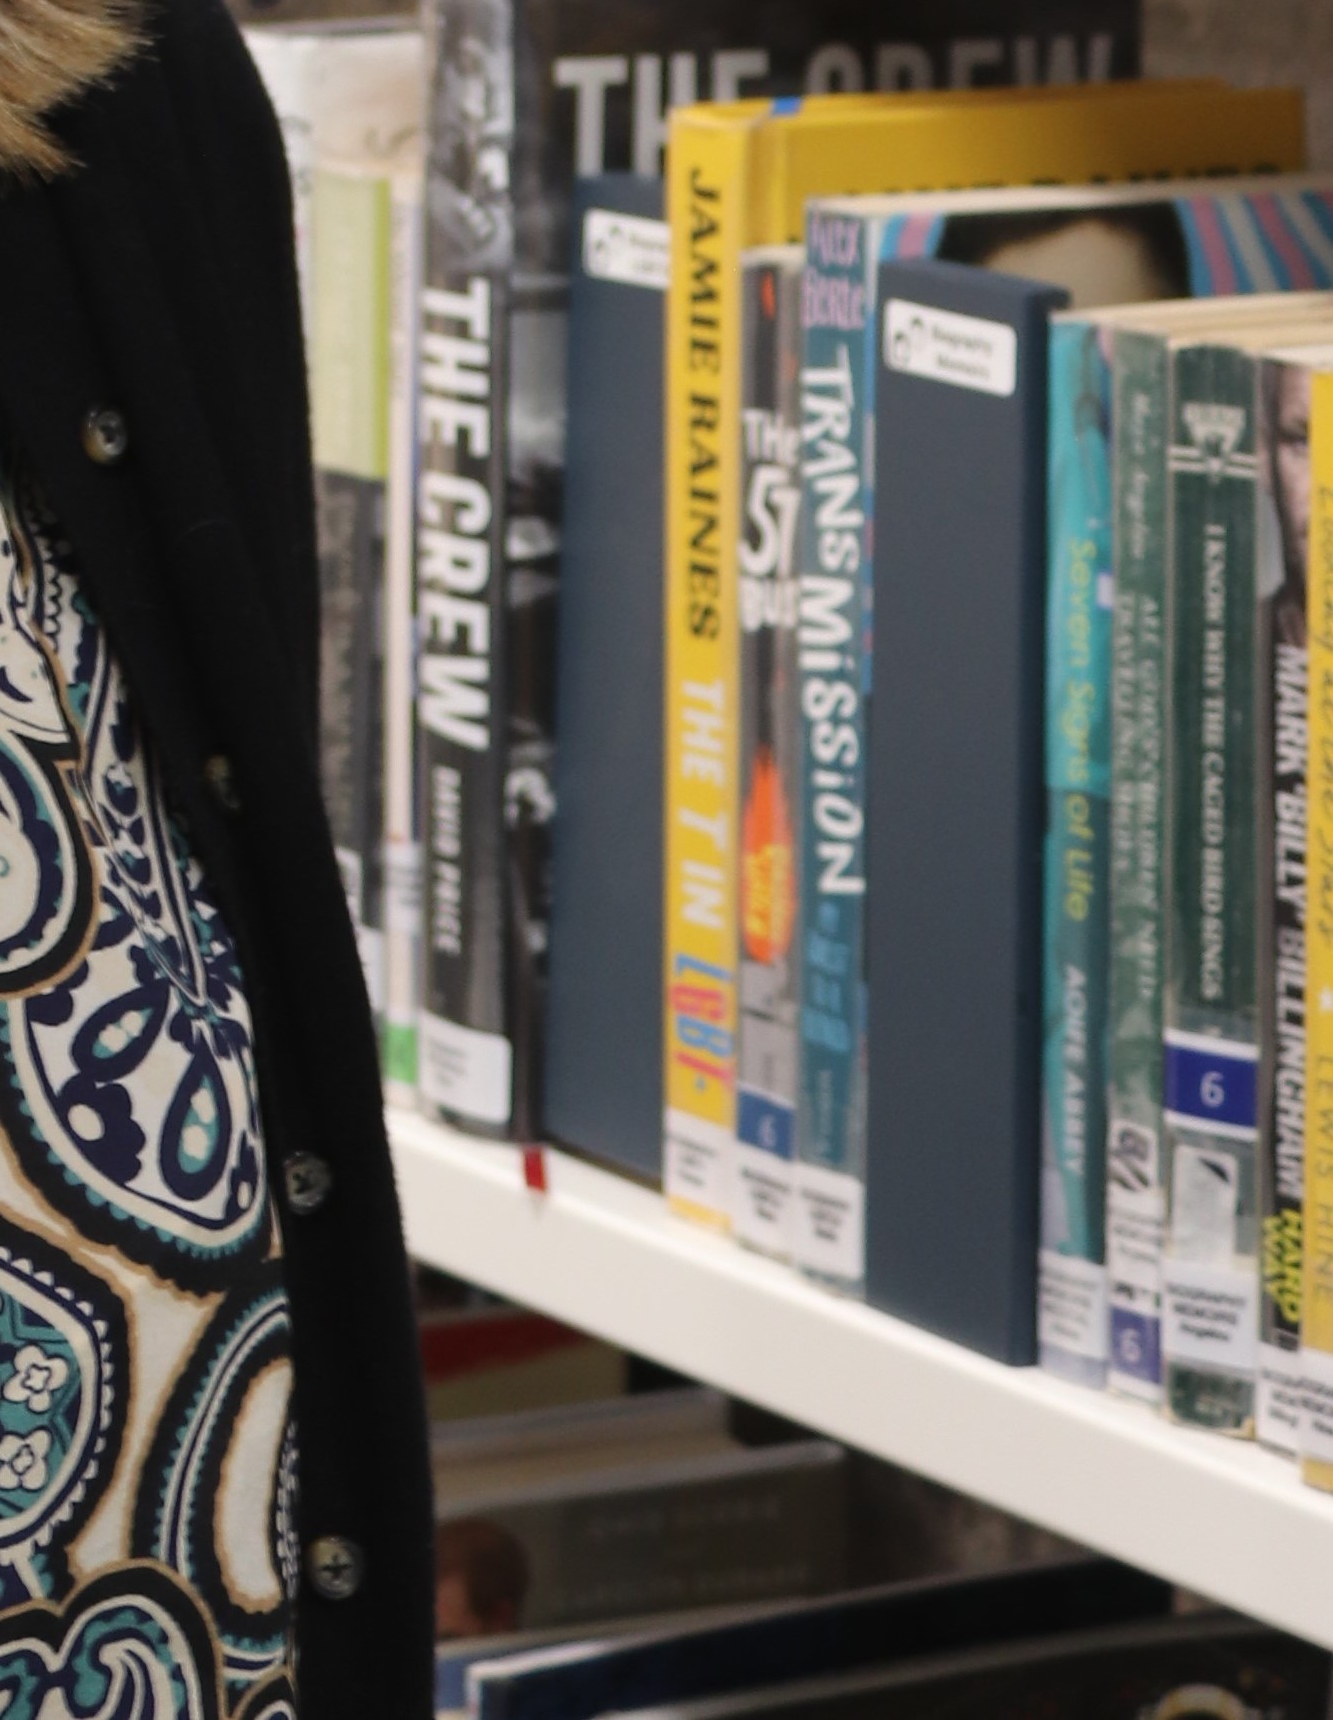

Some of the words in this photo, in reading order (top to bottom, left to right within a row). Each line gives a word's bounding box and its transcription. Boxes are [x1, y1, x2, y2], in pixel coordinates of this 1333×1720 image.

[687, 167, 723, 376] JAMIE
[809, 213, 861, 267] Alex
[415, 274, 492, 459] THE
[743, 407, 799, 464] THE
[687, 389, 723, 643] RAINES
[737, 464, 802, 577] 57
[415, 469, 492, 755] CREW
[1064, 537, 1096, 669] Seven
[1200, 537, 1226, 623] KNOW
[1200, 627, 1226, 691] WHY
[681, 677, 726, 789] THE
[1060, 680, 1096, 783] Signs
[1200, 691, 1226, 749] THE
[1273, 641, 1308, 776] MARK
[433, 764, 463, 860] DAVID
[681, 810, 729, 850] T
[1065, 795, 1096, 835] of
[1199, 751, 1226, 844] CAGED
[433, 862, 462, 958] PRICE
[680, 861, 727, 933] IN
[1065, 847, 1096, 921] Life
[1198, 846, 1225, 912] BIRD
[1198, 916, 1225, 1000] SINGS
[1199, 1069, 1226, 1109] 6
[1273, 925, 1307, 1204] BILLINGHAM
[1062, 1066, 1085, 1176] ABBEY
[1262, 1214, 1284, 1304] WAY
[1280, 1209, 1305, 1323] HARD
